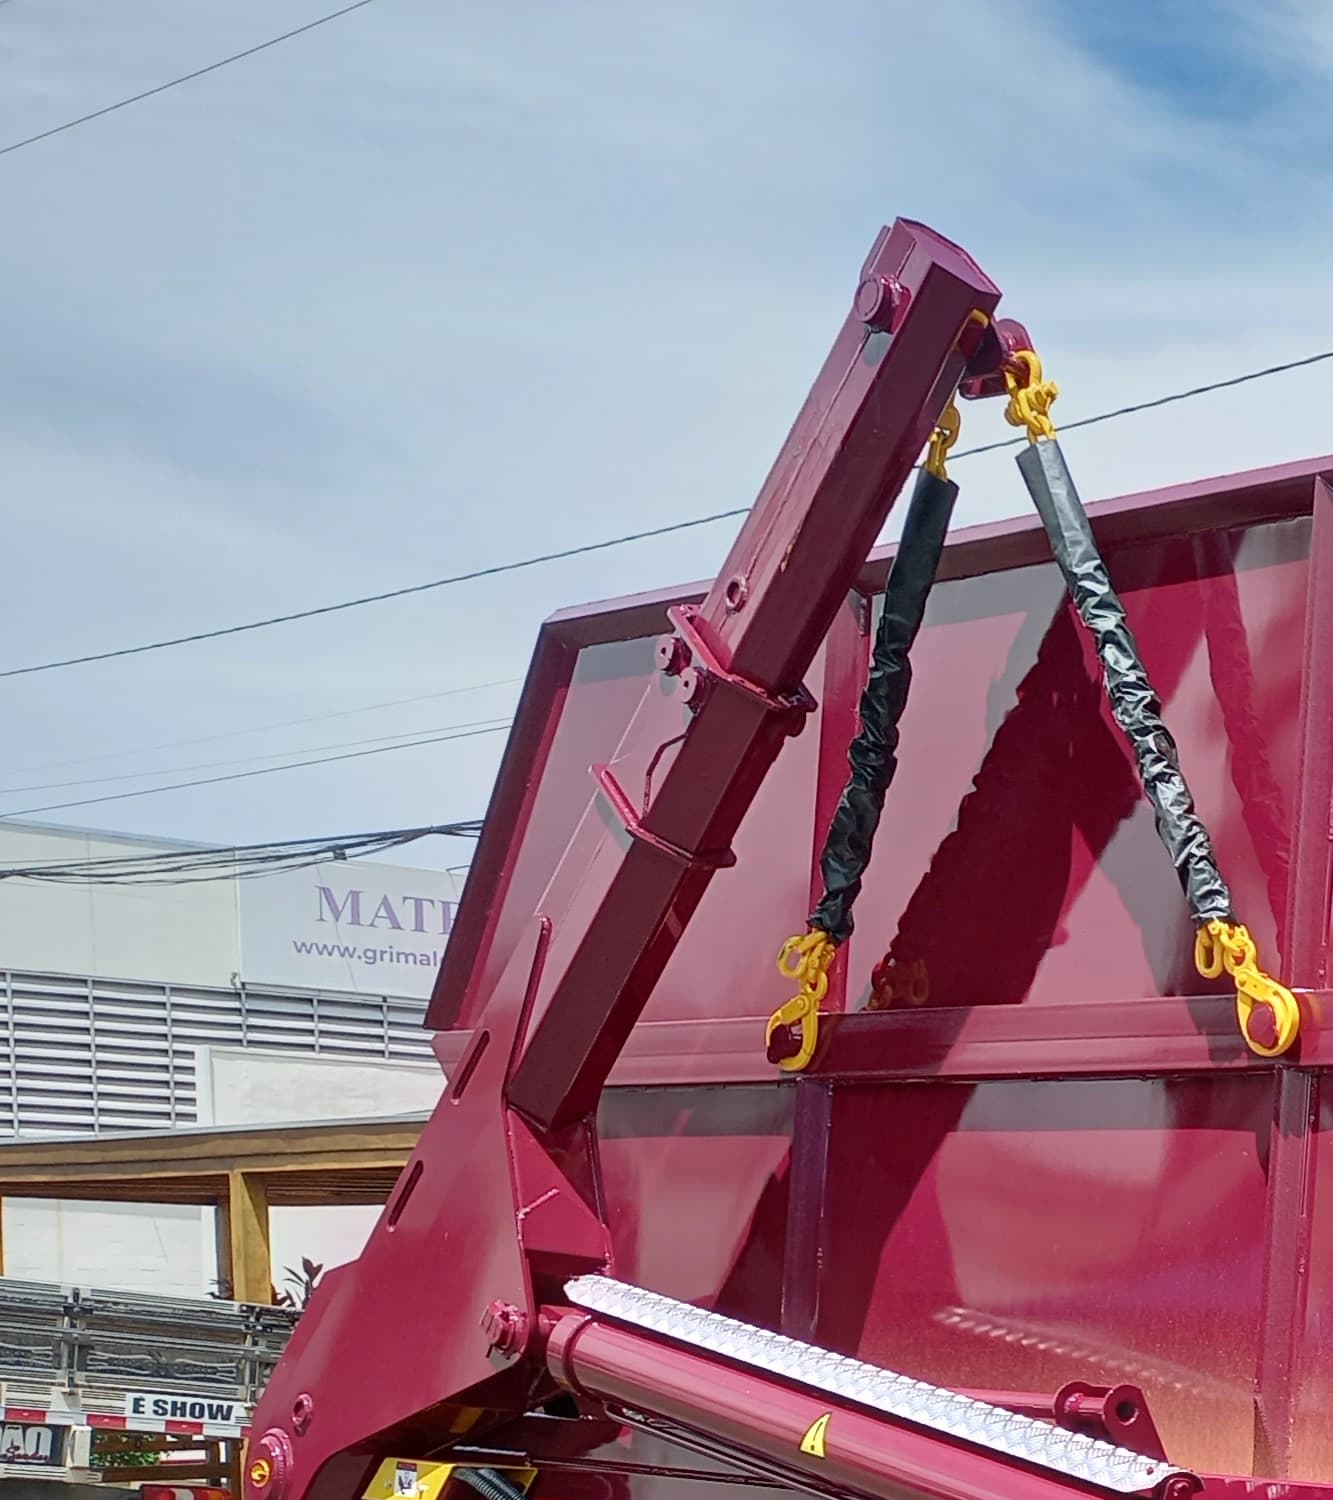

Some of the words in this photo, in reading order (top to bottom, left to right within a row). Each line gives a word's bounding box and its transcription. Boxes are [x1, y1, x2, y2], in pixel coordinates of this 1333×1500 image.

[292, 939, 445, 968] www.grimal
[153, 1398, 234, 1421] SHOW
[0, 1424, 53, 1461] ÃO
